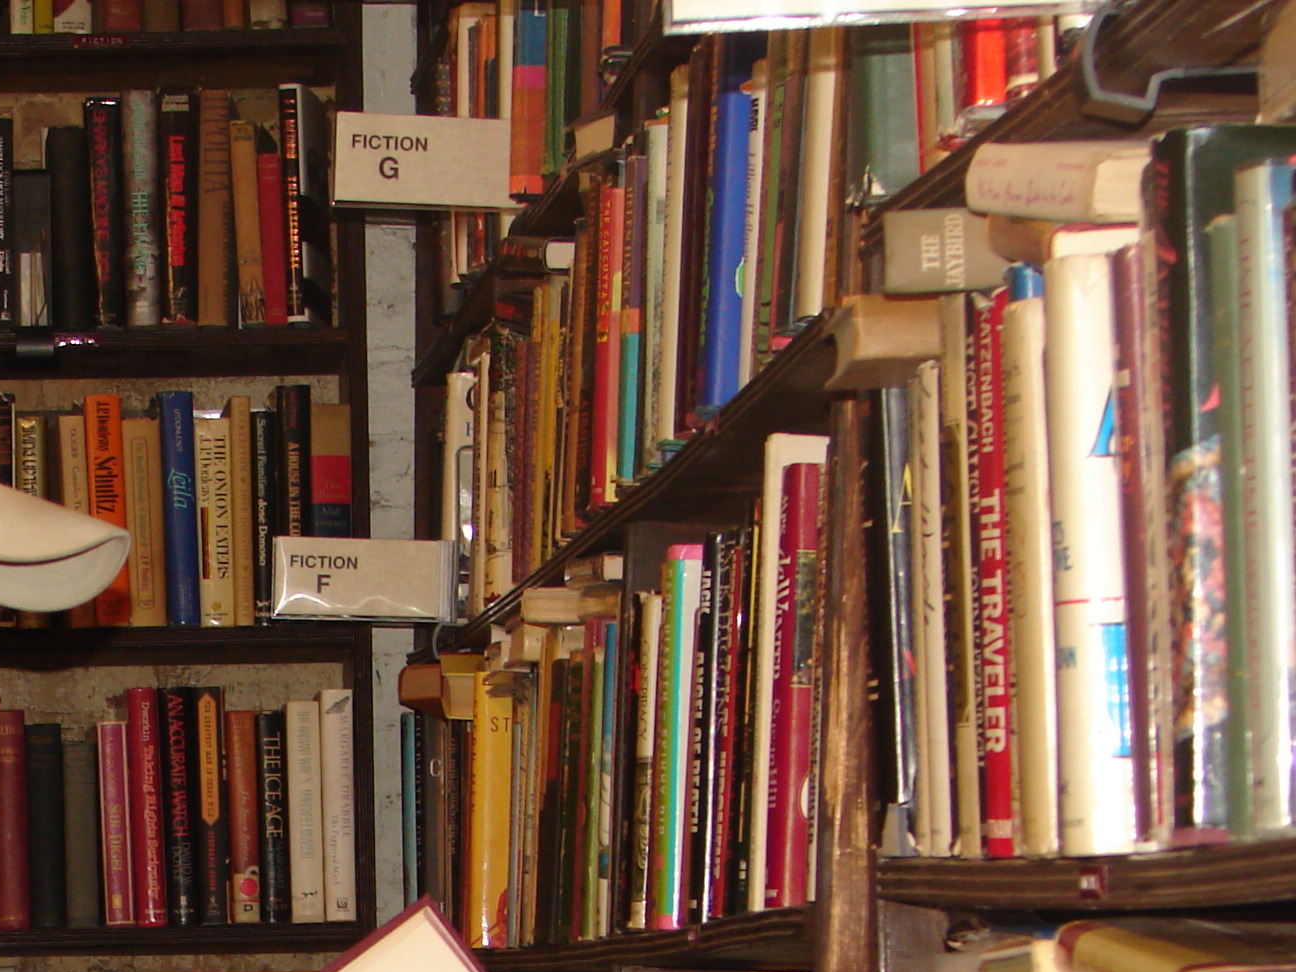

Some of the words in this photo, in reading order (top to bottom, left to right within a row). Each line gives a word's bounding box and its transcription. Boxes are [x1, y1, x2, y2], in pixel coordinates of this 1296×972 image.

[351, 133, 429, 153] FICTION
[378, 156, 400, 180] G
[921, 233, 941, 272] THE
[945, 214, 966, 288] JAYBIRD
[213, 434, 227, 461] THE
[256, 417, 268, 454] Sacred
[93, 455, 120, 514] Schultz
[167, 467, 195, 510] Leila
[257, 455, 268, 497] Families
[287, 450, 301, 484] HOUSE
[213, 469, 228, 519] ONION
[258, 524, 269, 567] Donoso
[979, 487, 1003, 562] THE
[215, 524, 231, 580] EATERS
[289, 554, 359, 570] FICTION
[315, 574, 331, 594] F
[980, 568, 1005, 753] TRAVELER
[167, 694, 185, 716] AN
[636, 638, 651, 742] CONSPIRACY
[140, 701, 151, 742] Dworkin
[142, 744, 155, 792] Taking
[168, 717, 188, 788] ACCURATE
[263, 731, 282, 770] THE
[339, 714, 352, 779] MARGARET
[264, 772, 282, 800] ICE
[143, 793, 158, 838] Rights
[171, 790, 190, 838] WATCH
[265, 801, 283, 839] AGE
[340, 784, 353, 839] DRABBLE
